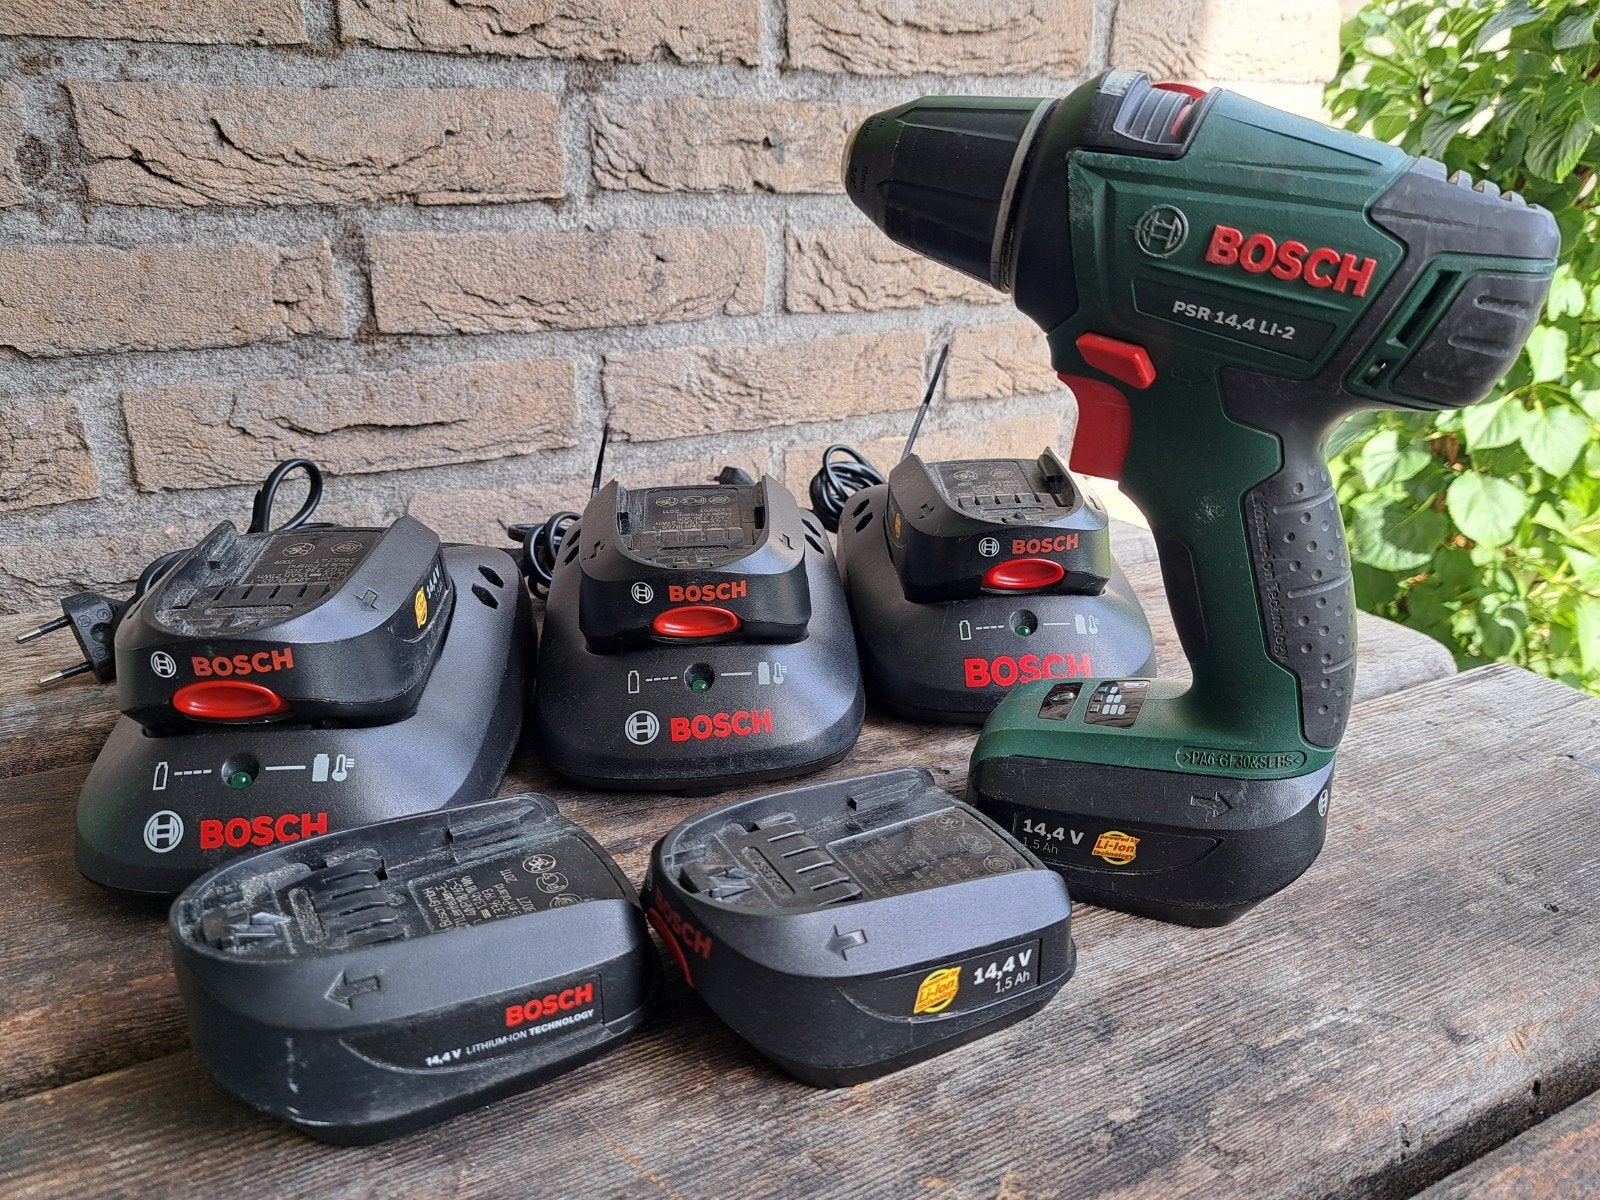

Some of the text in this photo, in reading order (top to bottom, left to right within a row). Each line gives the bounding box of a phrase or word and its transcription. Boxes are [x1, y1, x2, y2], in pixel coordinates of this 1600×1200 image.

[1205, 225, 1378, 297] BOSCH
[1173, 300, 1296, 341] PSR 14,4 LI-2
[1011, 533, 1079, 556] BOSCH
[668, 580, 748, 603] BOSCH
[192, 648, 294, 677] BOSCH
[963, 653, 1092, 688] BOSCH
[670, 709, 773, 742] BOSCH
[200, 812, 328, 849] BOSCH
[1023, 818, 1085, 845] 14,4 V
[1100, 834, 1139, 844] powered by
[1042, 842, 1058, 854] Ah
[1093, 849, 1134, 860] technology
[1096, 840, 1135, 853] Li-Ion
[655, 886, 713, 959] BOSCH
[974, 948, 1032, 986] 14,4 V
[919, 980, 955, 1001] Li-Ion
[994, 971, 1030, 994] 1,5 Ah
[505, 982, 593, 1027] BOSCH
[452, 1048, 462, 1059] V
[466, 1029, 528, 1055] LITHIUM-ION
[528, 1008, 595, 1036] TECHNOLOGY
